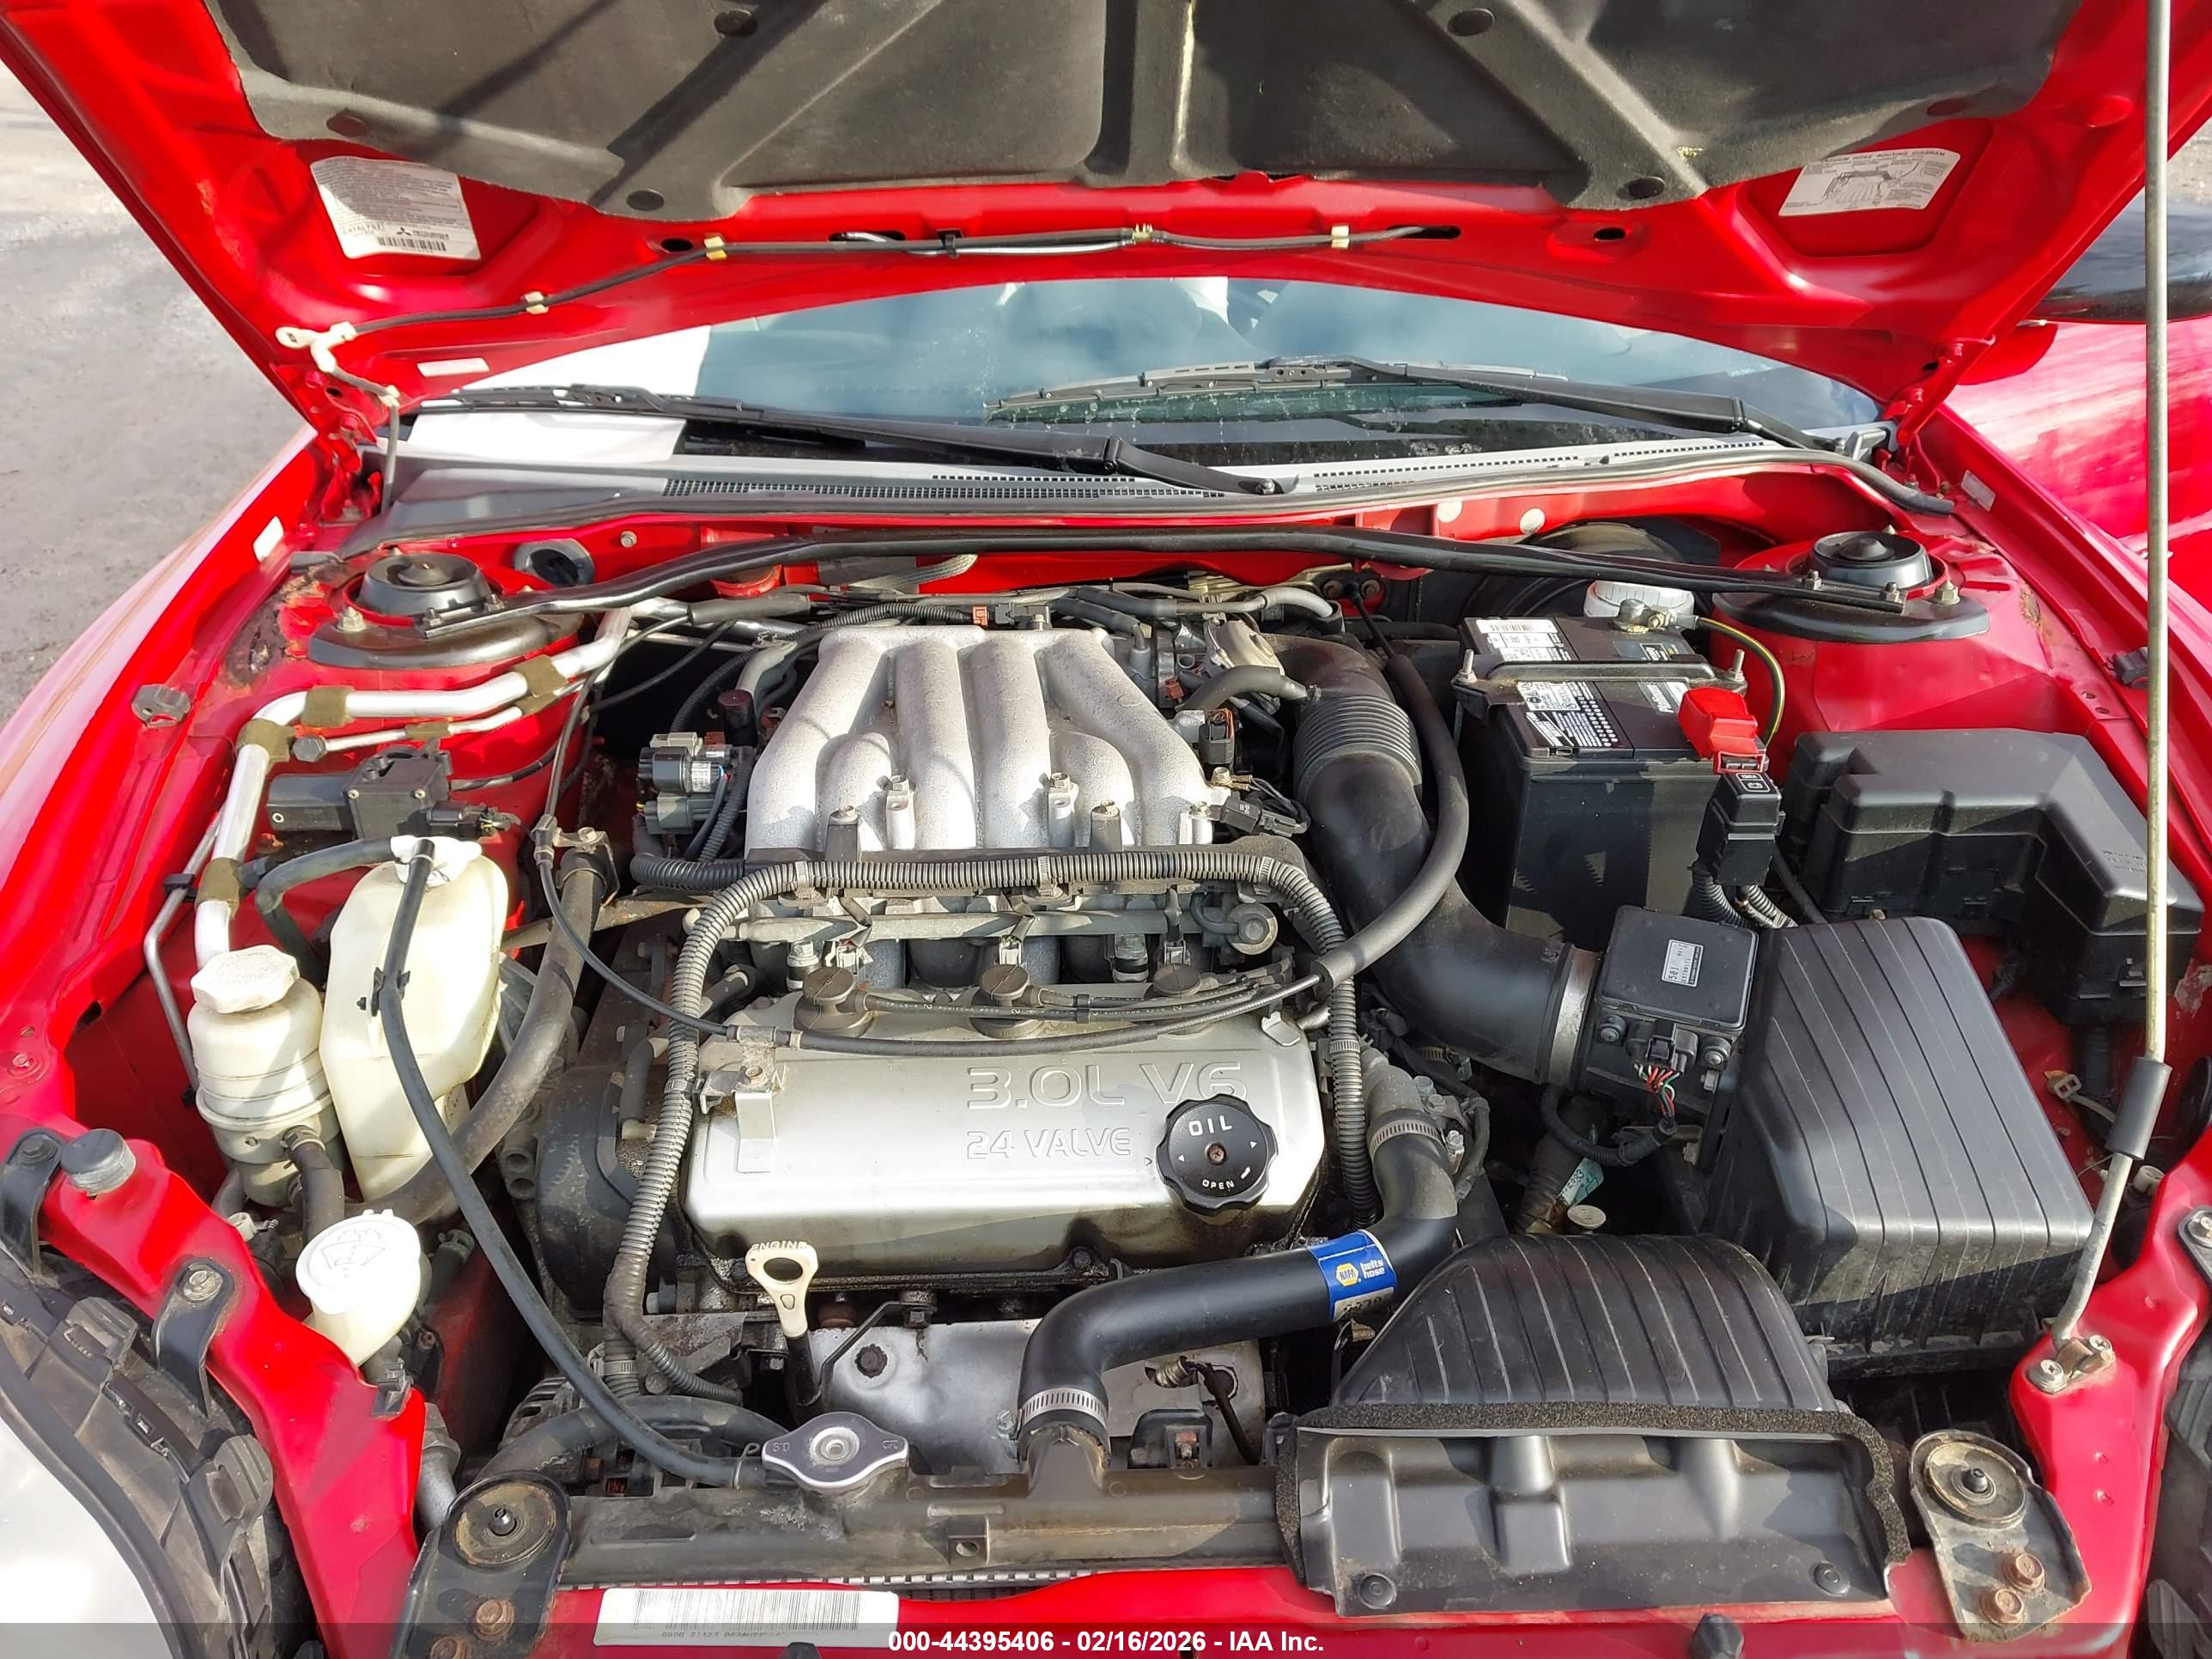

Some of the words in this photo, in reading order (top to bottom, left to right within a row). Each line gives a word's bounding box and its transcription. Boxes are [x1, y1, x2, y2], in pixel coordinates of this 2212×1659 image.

[1646, 684, 1674, 714] Platinum
[967, 1064, 1125, 1110] 3.0L
[1139, 1061, 1248, 1105] V6
[1188, 1115, 1233, 1137] OIL
[967, 1130, 1016, 1160] 24
[1024, 1127, 1131, 1157] VALVE
[1201, 1178, 1236, 1191] OPEN
[750, 1240, 807, 1251] ENGINE
[1360, 1259, 1384, 1272] belts
[1339, 1268, 1357, 1281] NAPA
[1364, 1267, 1385, 1279] hose
